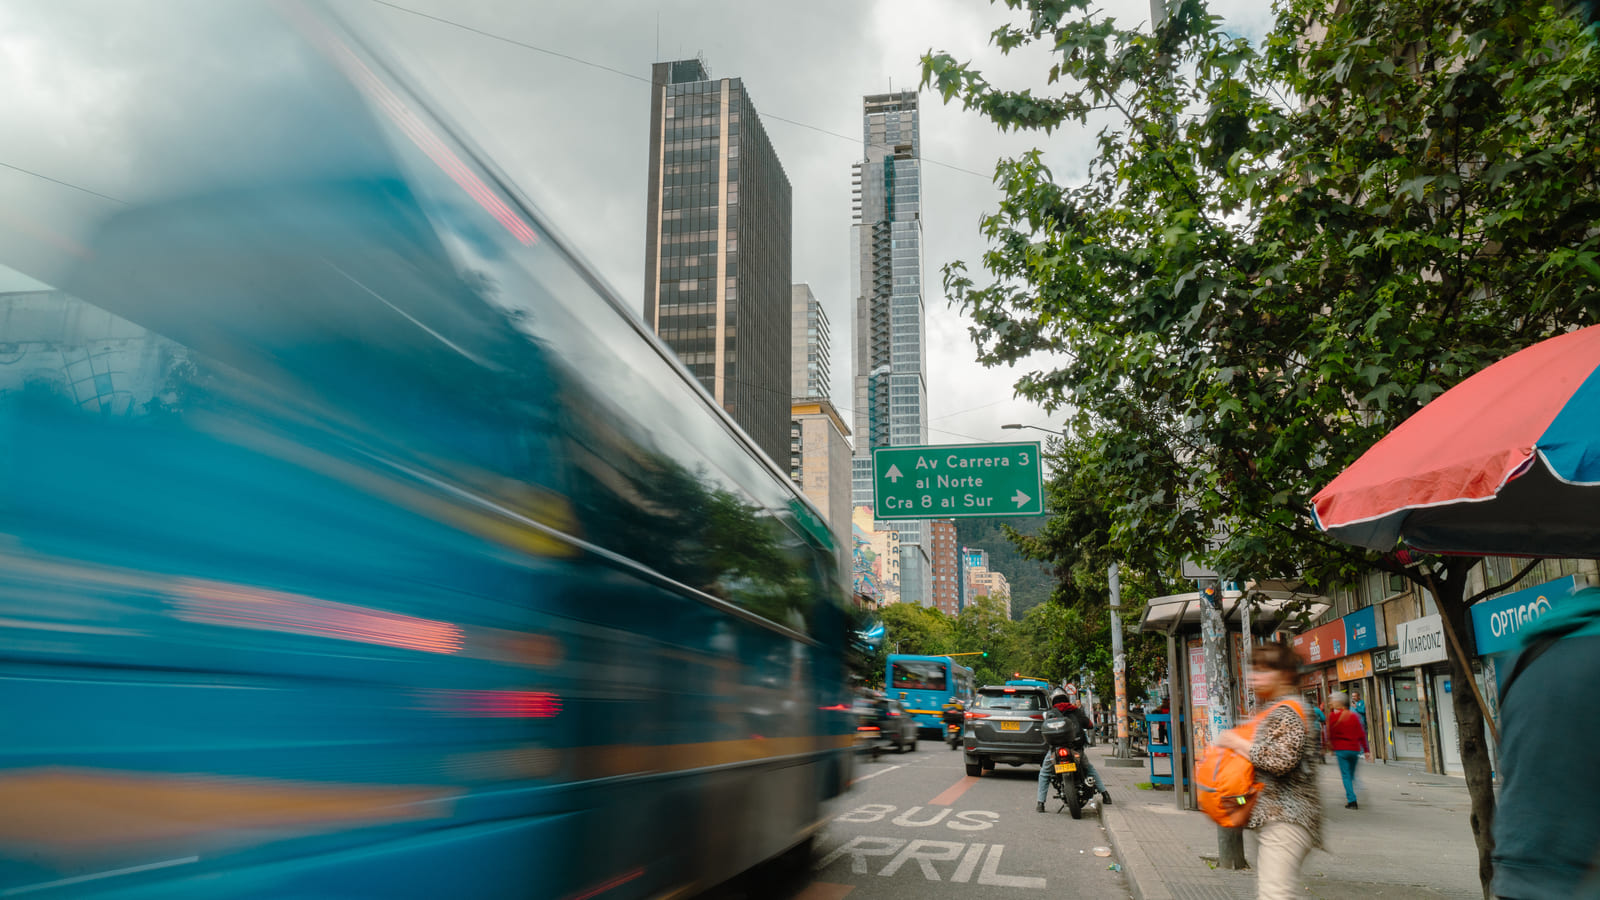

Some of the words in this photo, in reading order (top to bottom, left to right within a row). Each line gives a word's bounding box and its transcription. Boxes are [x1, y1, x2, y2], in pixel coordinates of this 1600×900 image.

[915, 455, 939, 470] Av
[946, 454, 1010, 469] Carrera
[1018, 452, 1030, 466] 3
[915, 477, 930, 489] al
[937, 474, 984, 488] Norte
[885, 496, 913, 509] Cra
[921, 495, 933, 508] 8
[941, 495, 955, 508] al
[963, 493, 994, 507] Sur
[834, 804, 1000, 831] BUS
